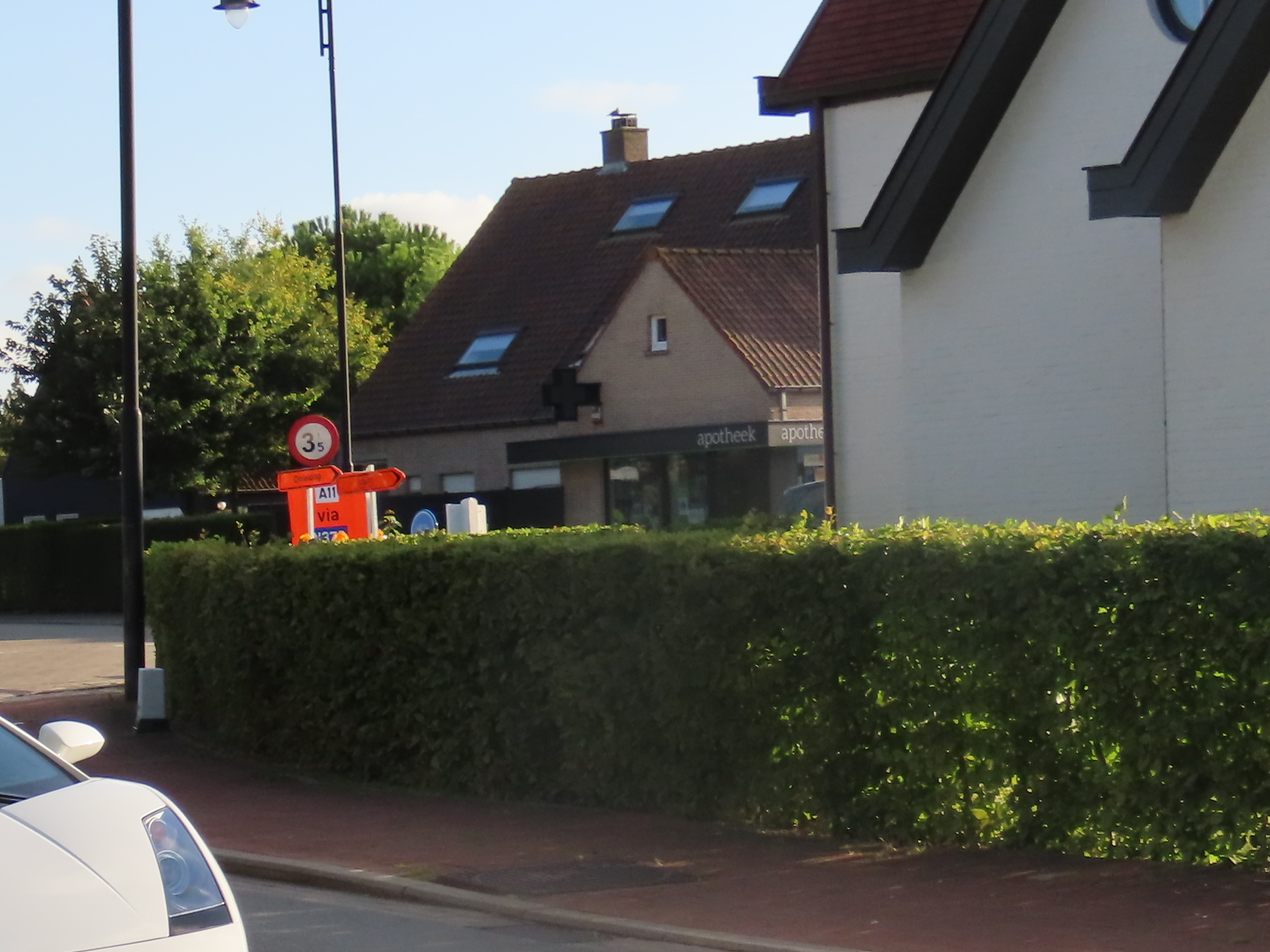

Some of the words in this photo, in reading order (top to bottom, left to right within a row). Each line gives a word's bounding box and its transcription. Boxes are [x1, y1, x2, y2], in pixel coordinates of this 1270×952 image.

[697, 425, 756, 448] apotheek
[319, 486, 336, 499] A11
[317, 508, 339, 522] via
